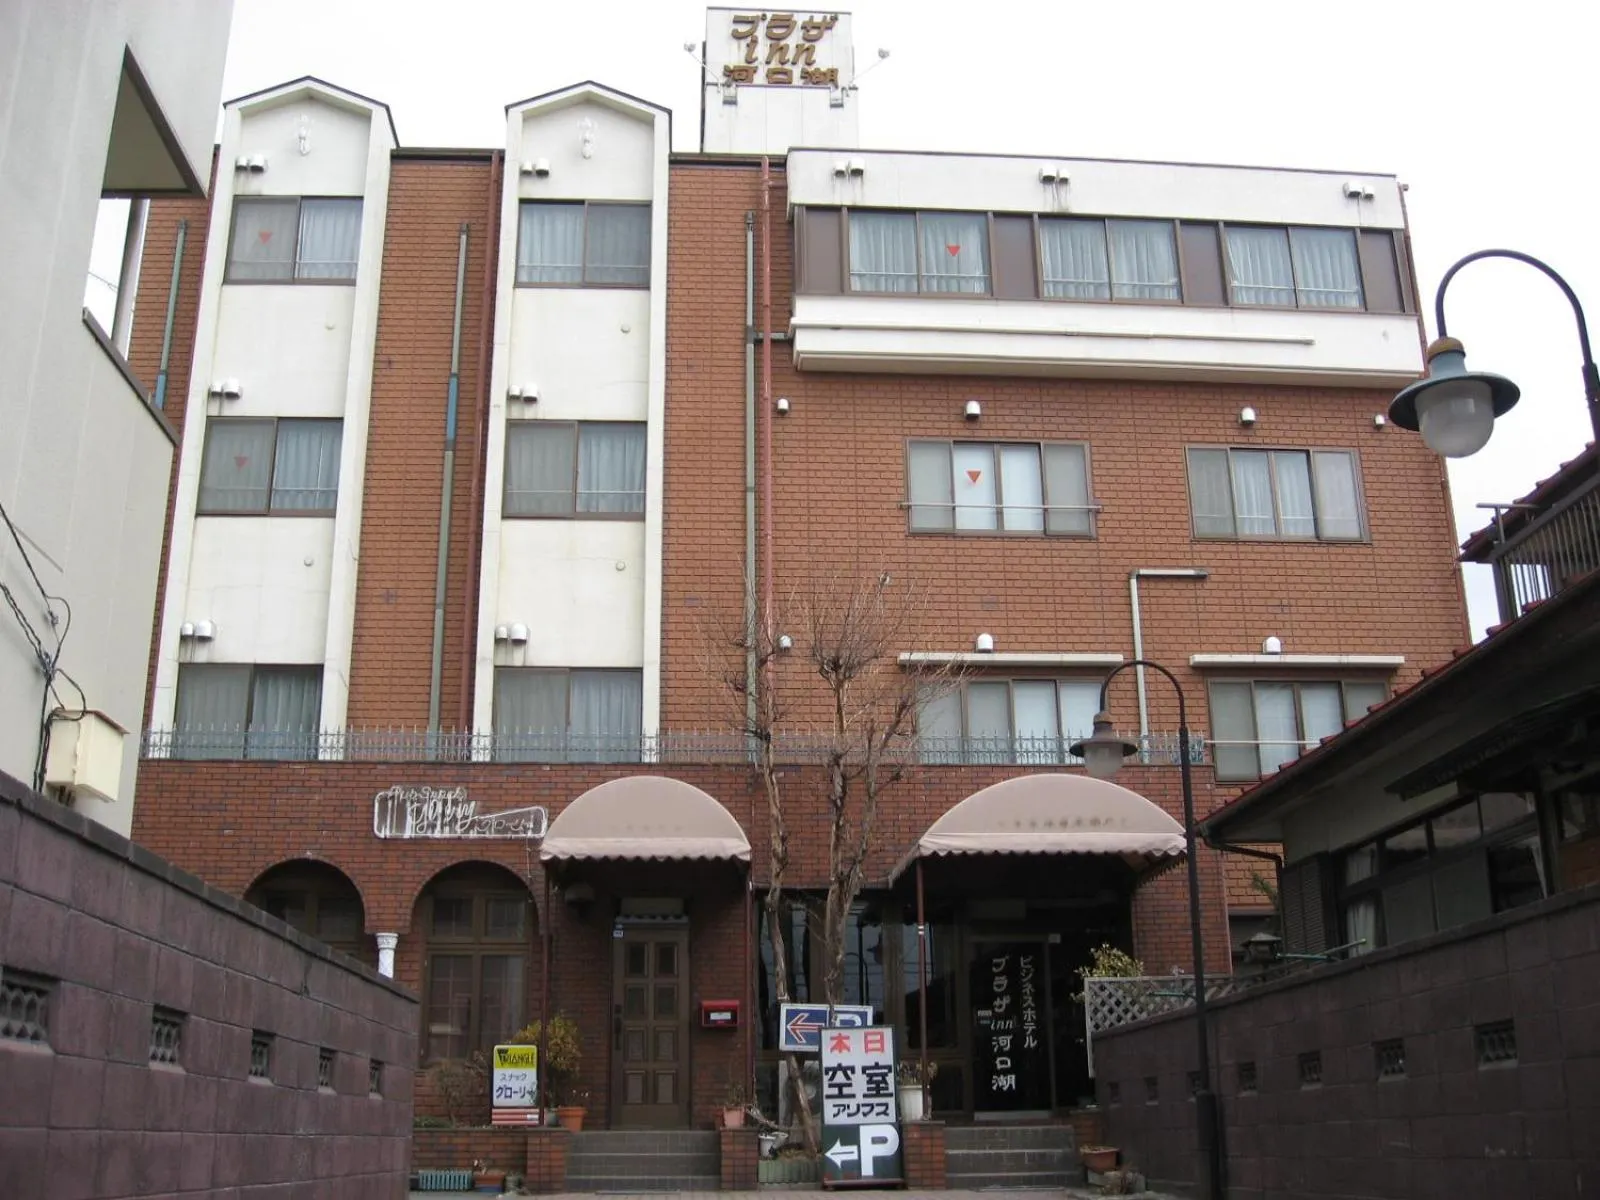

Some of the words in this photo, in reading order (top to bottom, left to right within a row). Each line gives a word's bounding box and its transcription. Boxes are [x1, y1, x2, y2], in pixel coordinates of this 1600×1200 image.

[732, 14, 838, 42] プラザ
[744, 36, 816, 65] inn
[723, 65, 839, 89] 河口湖
[1020, 955, 1038, 1049] ビジネスホテル
[830, 1031, 885, 1054] 本日
[824, 1062, 893, 1100] 空室
[832, 1102, 890, 1118] アリマス
[859, 1124, 900, 1177] P
